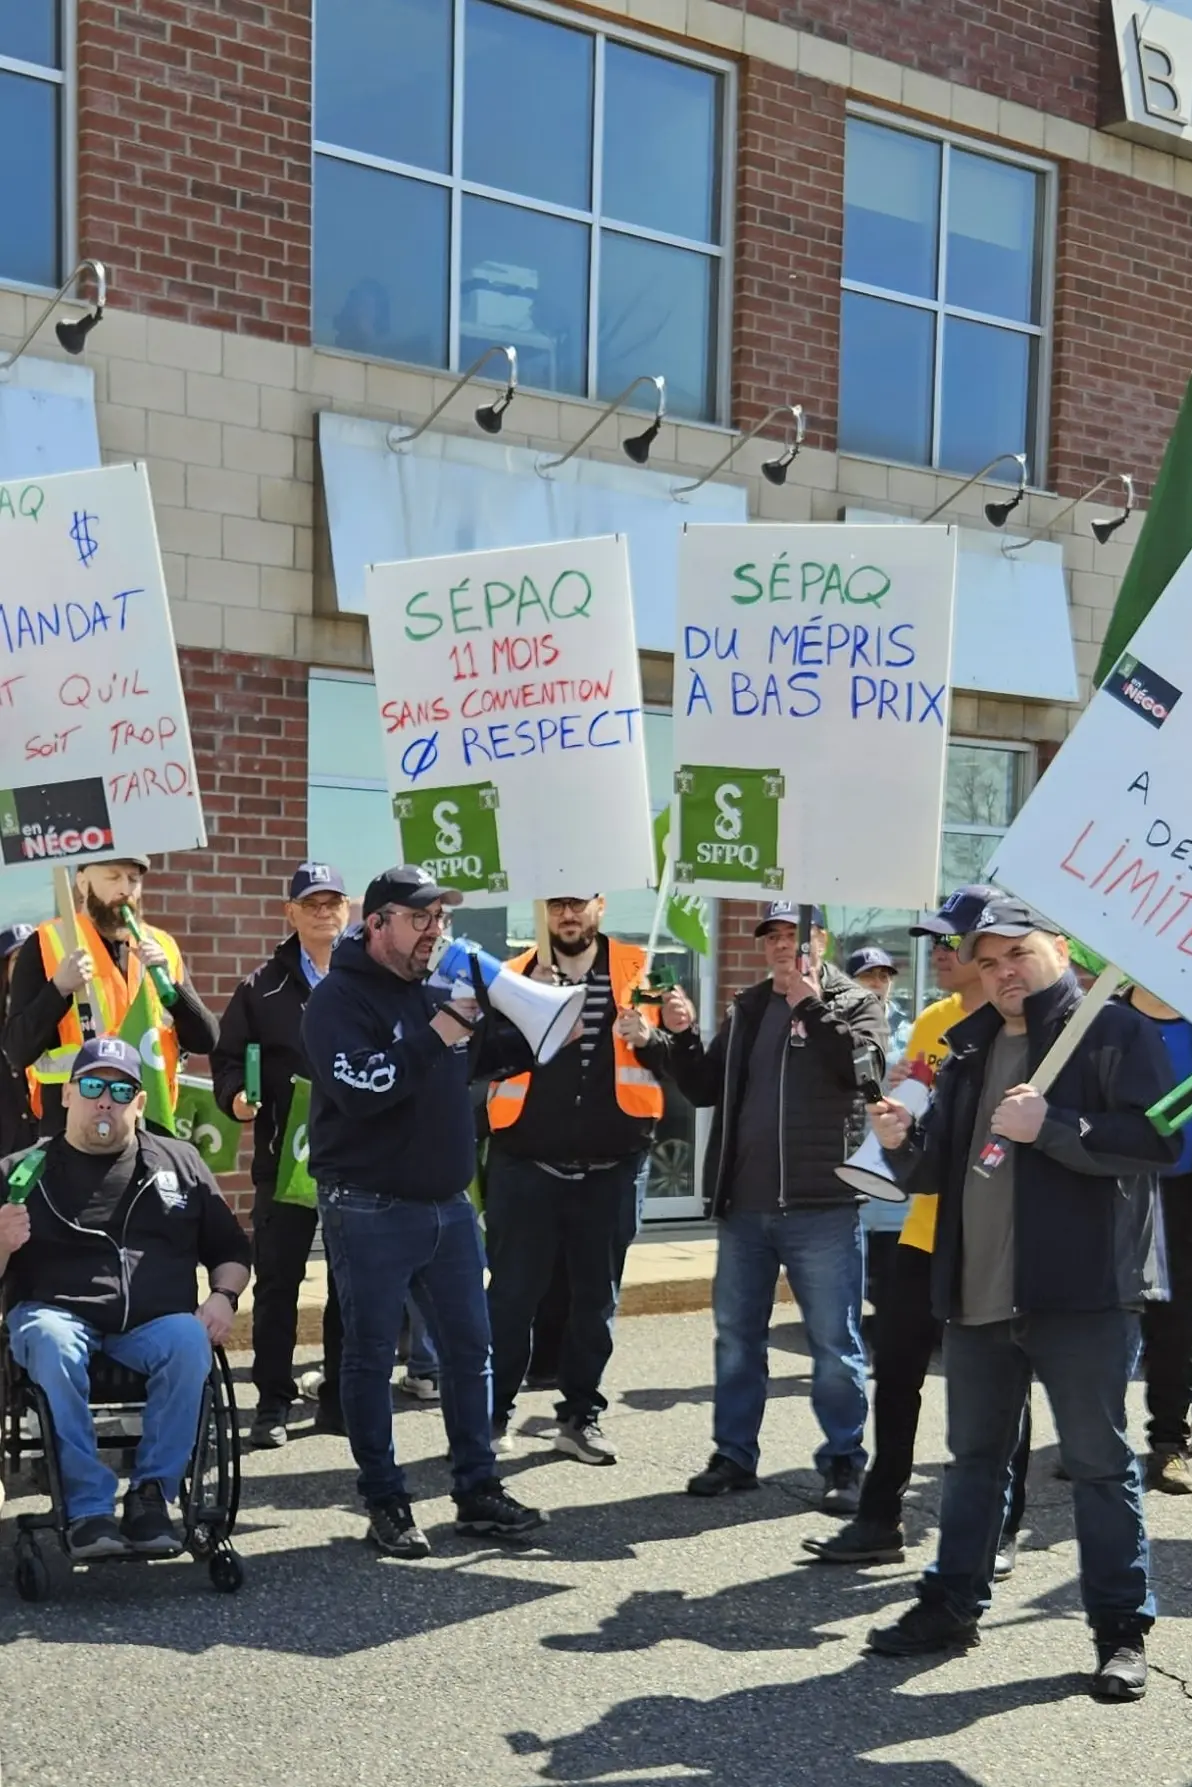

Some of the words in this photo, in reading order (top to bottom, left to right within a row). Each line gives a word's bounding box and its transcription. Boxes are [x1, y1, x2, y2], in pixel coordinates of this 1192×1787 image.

[731, 551, 891, 609] SÉPAQ
[404, 570, 592, 641] SÉPAQ
[449, 642, 479, 681] 11
[492, 634, 560, 675] MOIS
[684, 625, 739, 660] DU
[768, 615, 916, 668] MÉPRIS
[381, 697, 450, 734] SANS
[460, 670, 614, 719] CONVENTION
[686, 667, 713, 717] À
[731, 671, 822, 718] BAS
[851, 675, 946, 727] PRIX
[461, 707, 641, 767] RESPECT
[1127, 770, 1151, 805] A
[22, 822, 42, 836] en
[24, 825, 105, 859] NÉGO
[421, 855, 483, 879] SFPQ
[696, 842, 760, 871] SFPQ
